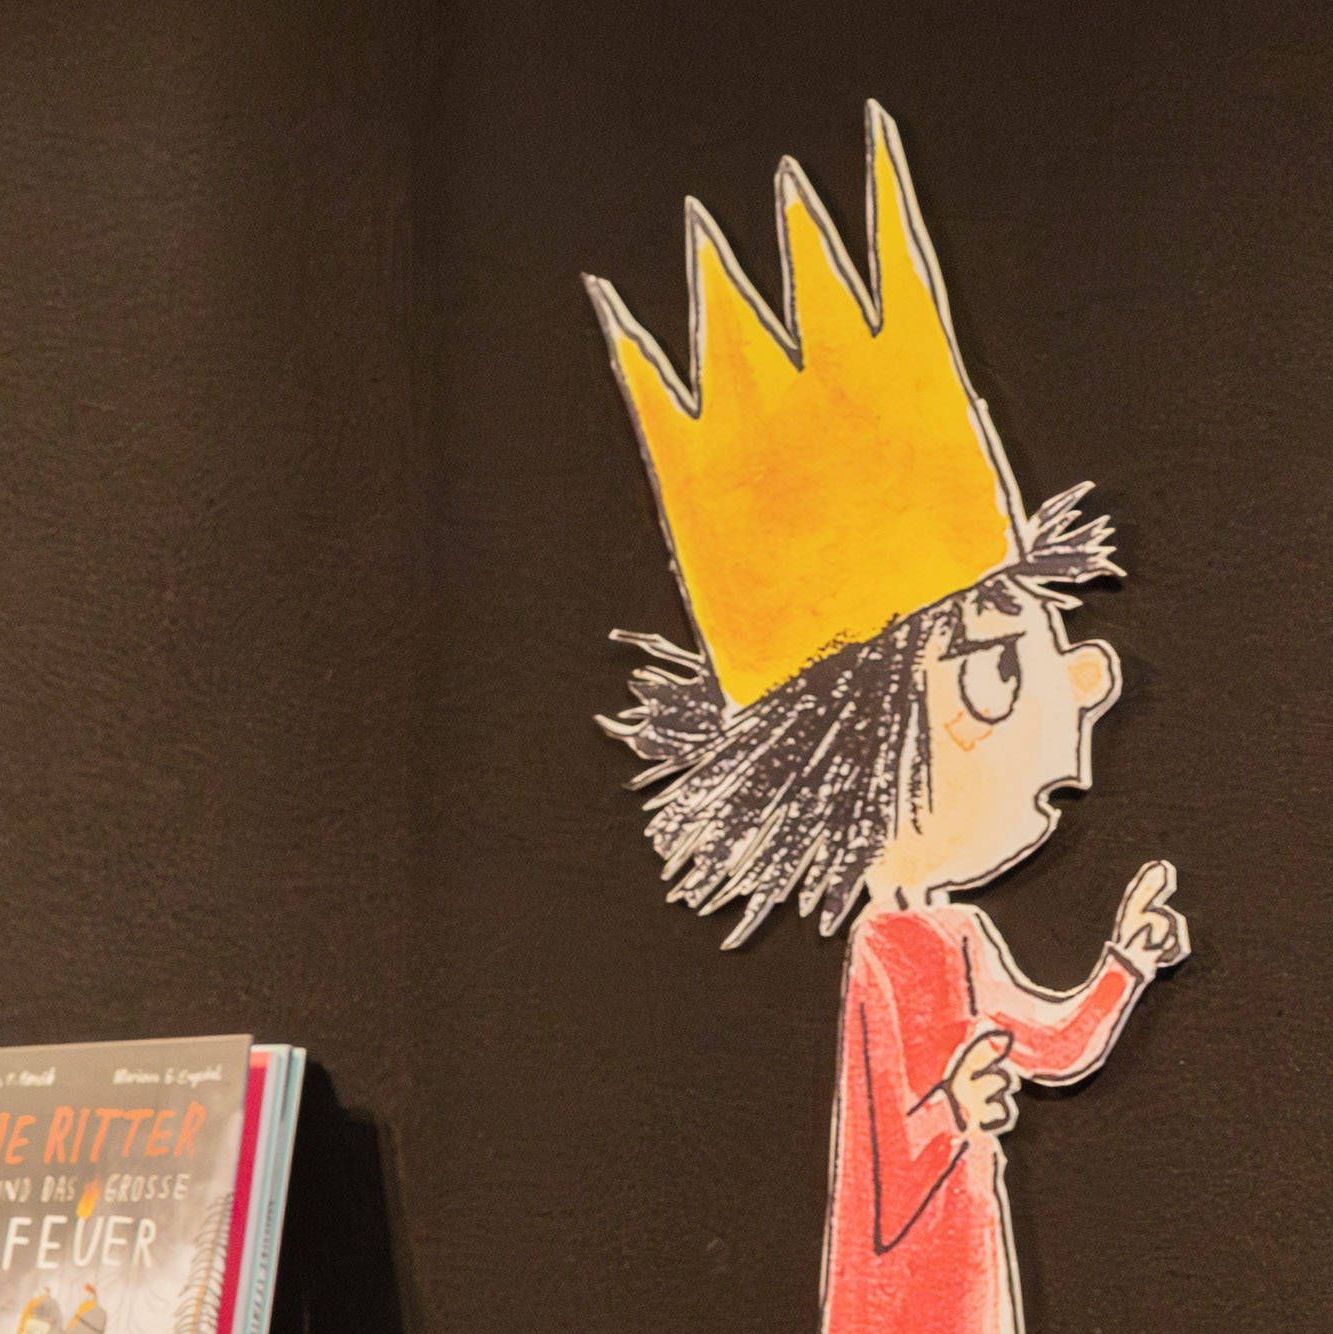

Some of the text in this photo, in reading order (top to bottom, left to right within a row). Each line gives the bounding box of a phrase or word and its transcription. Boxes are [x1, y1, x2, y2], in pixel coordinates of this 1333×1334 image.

[43, 1101, 207, 1165] RITTER
[40, 1174, 78, 1204] DAS
[104, 1172, 192, 1203] GROSSE
[1, 1214, 157, 1272] FEUER
